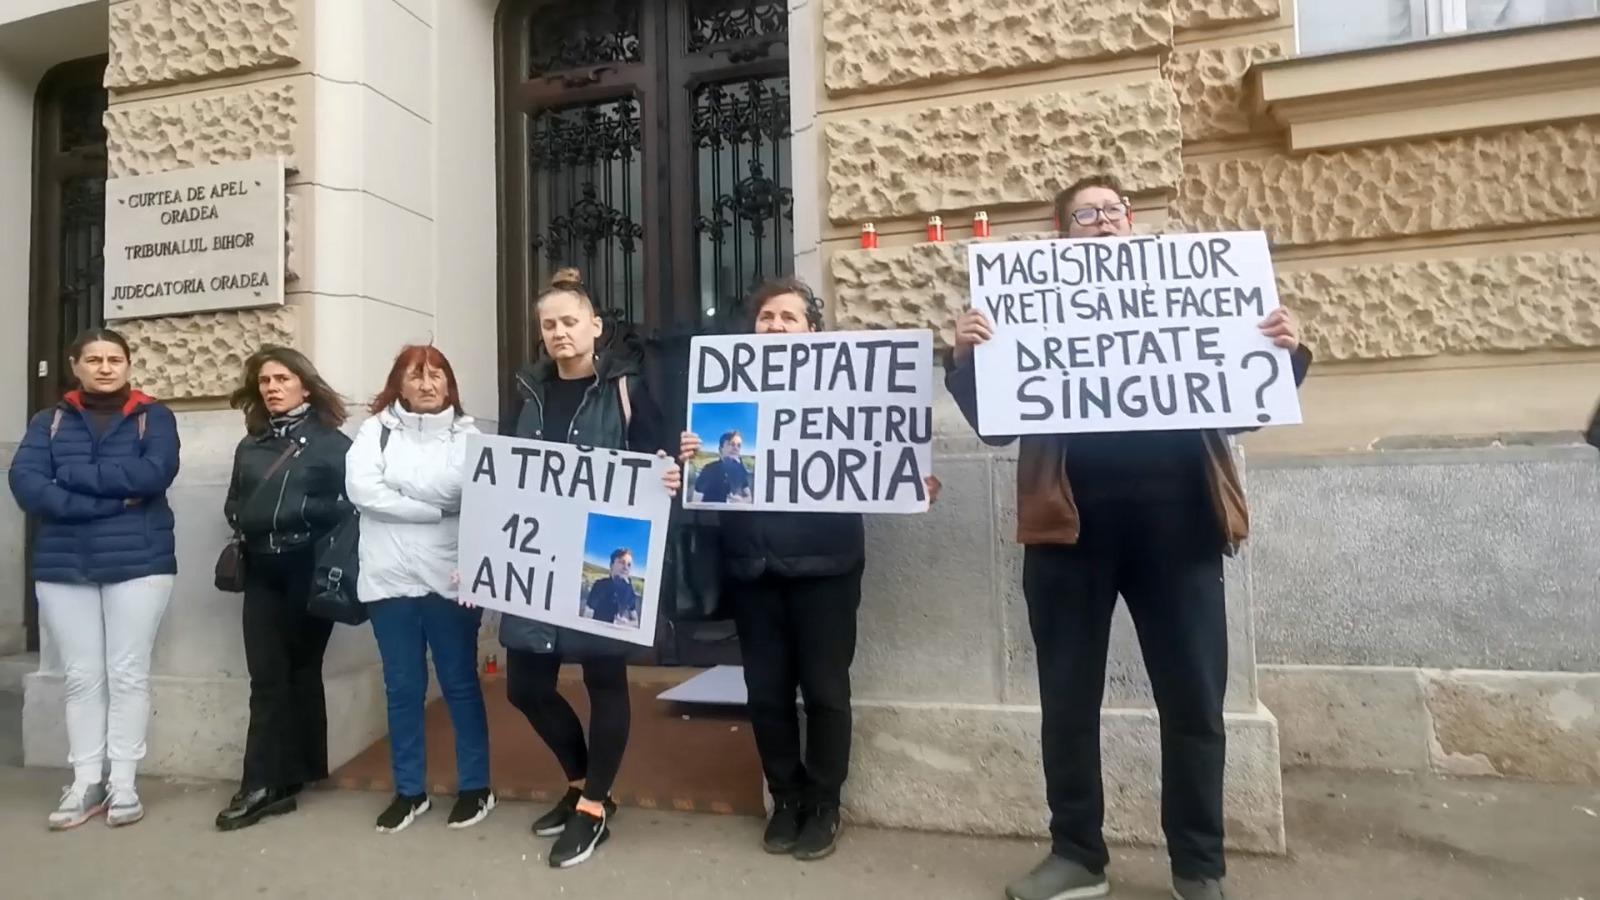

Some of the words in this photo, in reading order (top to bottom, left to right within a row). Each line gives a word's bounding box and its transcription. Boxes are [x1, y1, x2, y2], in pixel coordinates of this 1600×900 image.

[128, 190, 182, 208] CURTEA
[187, 186, 205, 202] DE
[210, 181, 248, 199] APEL
[161, 205, 219, 225] ORADEA
[125, 238, 207, 260] TRIBUNALUL
[212, 232, 254, 251] BIHOR
[111, 278, 205, 300] JUDECATORIA
[210, 272, 269, 291] ORADEA
[1166, 286, 1264, 318] FACEM
[697, 340, 919, 394] DREPTATE
[1016, 326, 1225, 372] DREPTATE
[772, 405, 933, 444] PENTRU
[472, 446, 497, 486] A
[765, 441, 926, 504] HORIA
[501, 513, 541, 555] 12
[471, 555, 556, 611] ANI
